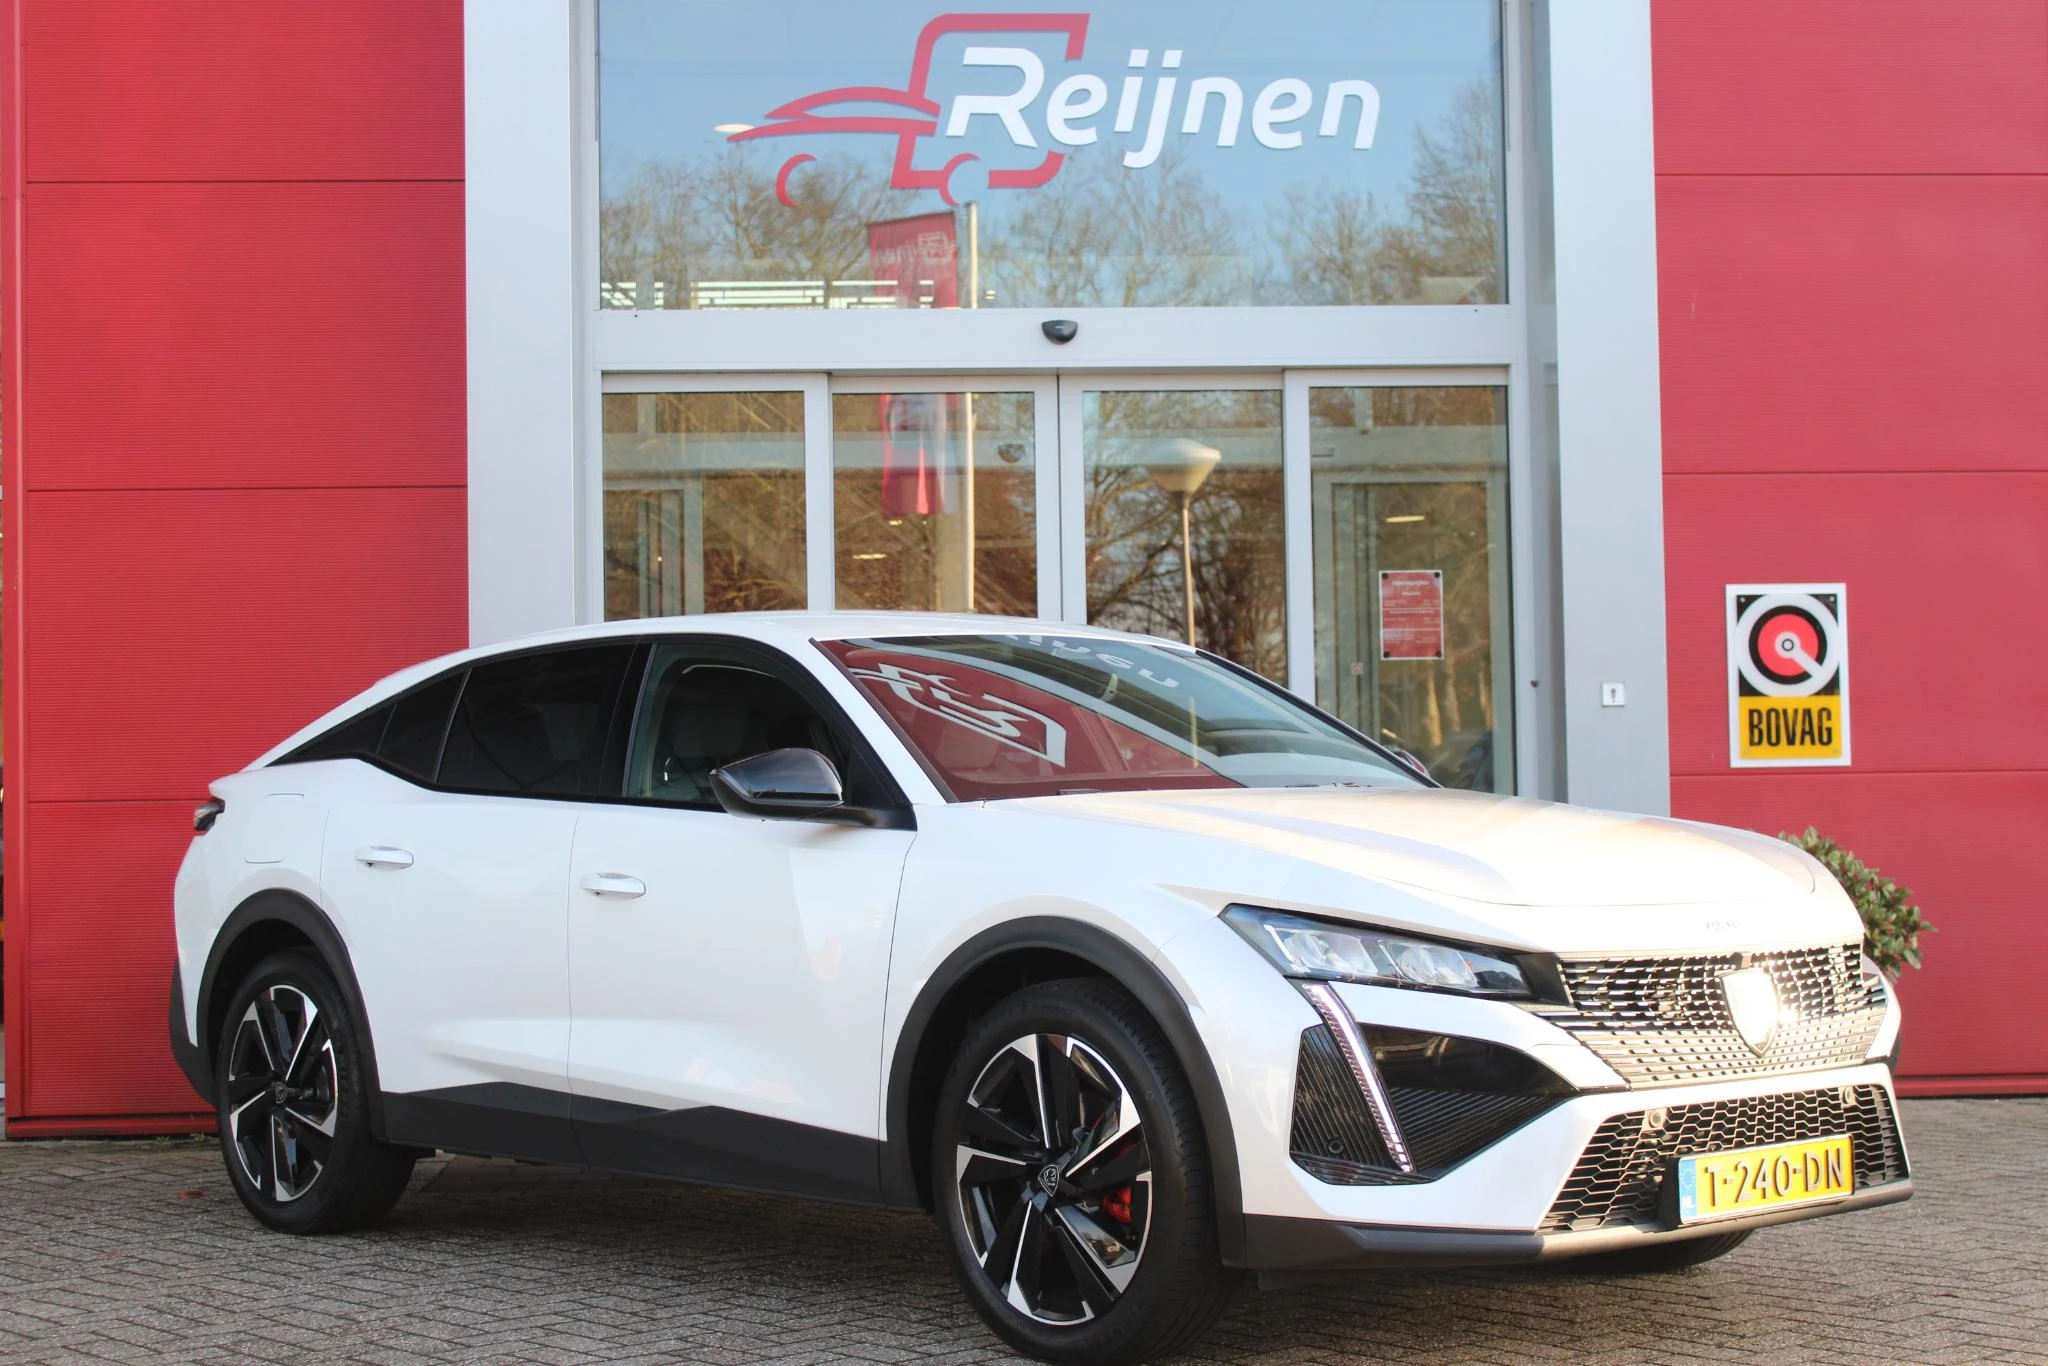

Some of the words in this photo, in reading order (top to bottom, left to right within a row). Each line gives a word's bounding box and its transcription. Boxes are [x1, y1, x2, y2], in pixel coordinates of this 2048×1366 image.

[945, 47, 1382, 169] Reijnen
[1748, 707, 1833, 747] BOVAG
[1703, 1147, 1844, 1207] T-240-DN
